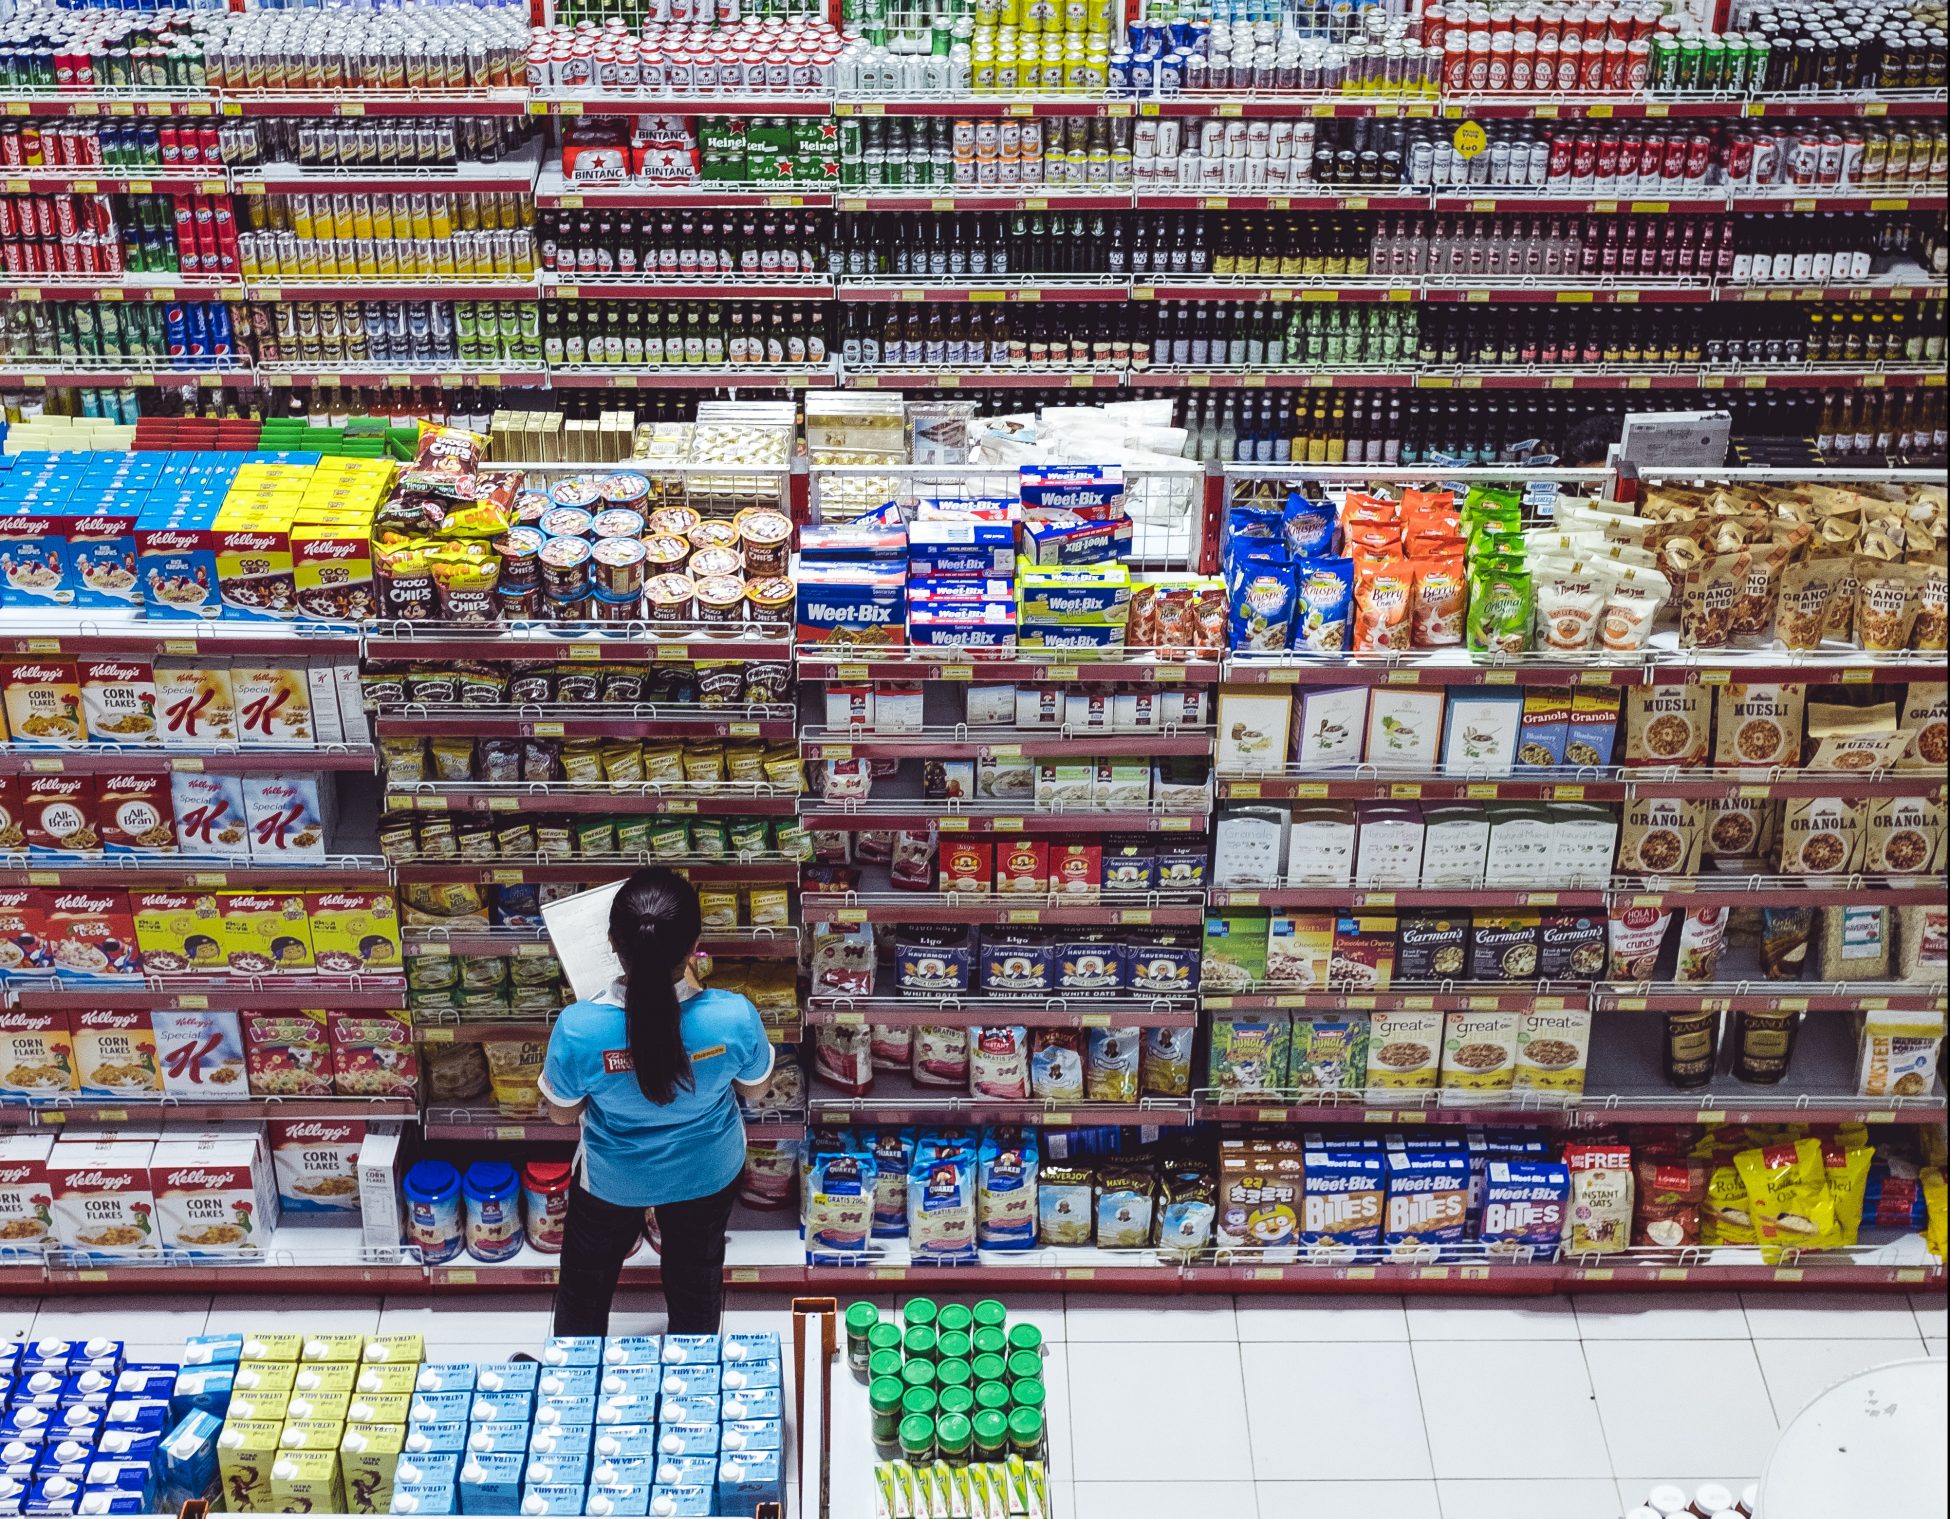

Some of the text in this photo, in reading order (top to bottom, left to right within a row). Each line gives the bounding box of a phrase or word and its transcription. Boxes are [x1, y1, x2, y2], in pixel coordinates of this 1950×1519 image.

[638, 130, 686, 141] BINTANG
[574, 168, 623, 179] BINTANG
[645, 166, 693, 177] BINTANG
[436, 437, 471, 449] CHOCO
[429, 444, 471, 460] CHIPS
[1047, 472, 1095, 481] Weet-Bix
[1041, 492, 1103, 507] Weet-Bix
[939, 500, 1001, 511] Weet-Bix
[0, 518, 49, 532] Kellogg's
[75, 518, 127, 532] Kellogg's
[147, 533, 199, 547] Kellogg's
[224, 533, 276, 547] Kellogg's
[304, 542, 357, 556] Kellogg's
[938, 558, 985, 571] Weet-Bix
[390, 589, 431, 602] CHIPS
[451, 592, 484, 600] CHOCO
[937, 586, 985, 597] Weet-Bix
[1302, 585, 1345, 596] Knusper
[1373, 590, 1403, 601] Berry
[1423, 585, 1455, 597] Berry
[448, 601, 490, 612] CHIPS
[1050, 596, 1102, 611] Weet-Bix
[1484, 598, 1523, 614] Original
[1873, 600, 1901, 609] BITES
[807, 604, 892, 623] Weet-Bix
[938, 609, 987, 619] Weet-Bix
[932, 630, 996, 646] Weet-Bix
[1045, 635, 1099, 648] Weet-Bix
[12, 666, 63, 681] Kellogg's
[89, 664, 139, 678] Kellogg's
[177, 673, 208, 683] Kellogg's
[252, 673, 284, 683] Kellogg's
[103, 688, 135, 699] CORN
[162, 685, 195, 695] Special
[238, 684, 271, 694] Special
[28, 690, 55, 700] CORN
[30, 699, 56, 708] FLAKES
[105, 699, 137, 708] FLAKES
[1643, 699, 1697, 712] MUESLI
[165, 689, 216, 736] K
[242, 689, 291, 736] K
[1734, 703, 1789, 716] MUESLI
[1523, 711, 1568, 723] Granola
[1571, 712, 1616, 722] Granola
[1526, 733, 1556, 741] Blueberry
[1574, 731, 1603, 741] Blueberry
[1836, 741, 1890, 749] MUESLI
[566, 757, 594, 767] ENERGEN
[688, 763, 717, 771] ENERGEN
[733, 760, 762, 768] ENERGEN
[31, 778, 81, 793] Kellogg's
[107, 777, 157, 791] Kellogg's
[188, 779, 222, 791] Kellogg's
[261, 785, 298, 797] Kellogg's
[179, 793, 212, 805] Special
[252, 802, 287, 812] Special
[57, 810, 73, 820] All-
[129, 809, 146, 819] All-
[48, 817, 77, 828] Bran
[123, 815, 152, 826] Bran
[182, 800, 229, 844] K
[1630, 813, 1695, 827] GRANOLA
[1791, 818, 1857, 831] GRANOLA
[1873, 814, 1939, 828] GRANOLA
[257, 804, 304, 850] K
[54, 895, 114, 911] Kellogg's
[141, 895, 187, 908] Kellogg's
[229, 895, 275, 908] Kellogg's
[319, 894, 365, 907] Kellogg's
[1628, 909, 1649, 919] HOLA
[1403, 928, 1463, 944] Carman's
[1475, 927, 1535, 943] Carman's
[1543, 924, 1603, 943] Carman's
[920, 938, 942, 946] Ligo
[1007, 936, 1028, 944] Ligo
[1370, 940, 1395, 948] Cherry
[1627, 938, 1654, 949] crunch
[908, 951, 952, 959] HAVERMOUT
[0, 1013, 52, 1027] Kellogg's
[81, 1012, 138, 1025] Kellogg's
[176, 1018, 214, 1027] Kellogg's
[1380, 1020, 1424, 1039] great
[1457, 1020, 1500, 1040] great
[1527, 1014, 1569, 1035] great
[160, 1031, 201, 1041] Special
[12, 1039, 43, 1048] CORN
[98, 1037, 129, 1047] CORN
[14, 1047, 45, 1056] FLAKES
[100, 1046, 131, 1055] FLAKES
[165, 1032, 224, 1084] K
[286, 1123, 351, 1140] Kellogg's
[303, 1151, 338, 1162] CORN
[1585, 1153, 1630, 1168] FREE
[304, 1161, 340, 1170] FLAKES
[1326, 1160, 1361, 1168] Weet-Bix
[1412, 1160, 1447, 1168] Weet-Bix
[65, 1171, 133, 1190] Kellogg's
[168, 1169, 234, 1188] Kellogg's
[1307, 1177, 1377, 1190] Weet-Bix
[1391, 1176, 1461, 1191] Weet-Bix
[1511, 1174, 1546, 1182] Weet-Bix
[929, 1185, 954, 1193] QUAKER
[1489, 1187, 1562, 1200] Weet-Bix
[84, 1200, 121, 1211] CORN
[186, 1199, 223, 1210] CORN
[828, 1196, 850, 1204] GRATIS
[1590, 1200, 1612, 1208] OATS
[87, 1210, 123, 1220] FLAKES
[188, 1208, 225, 1218] FLAKES
